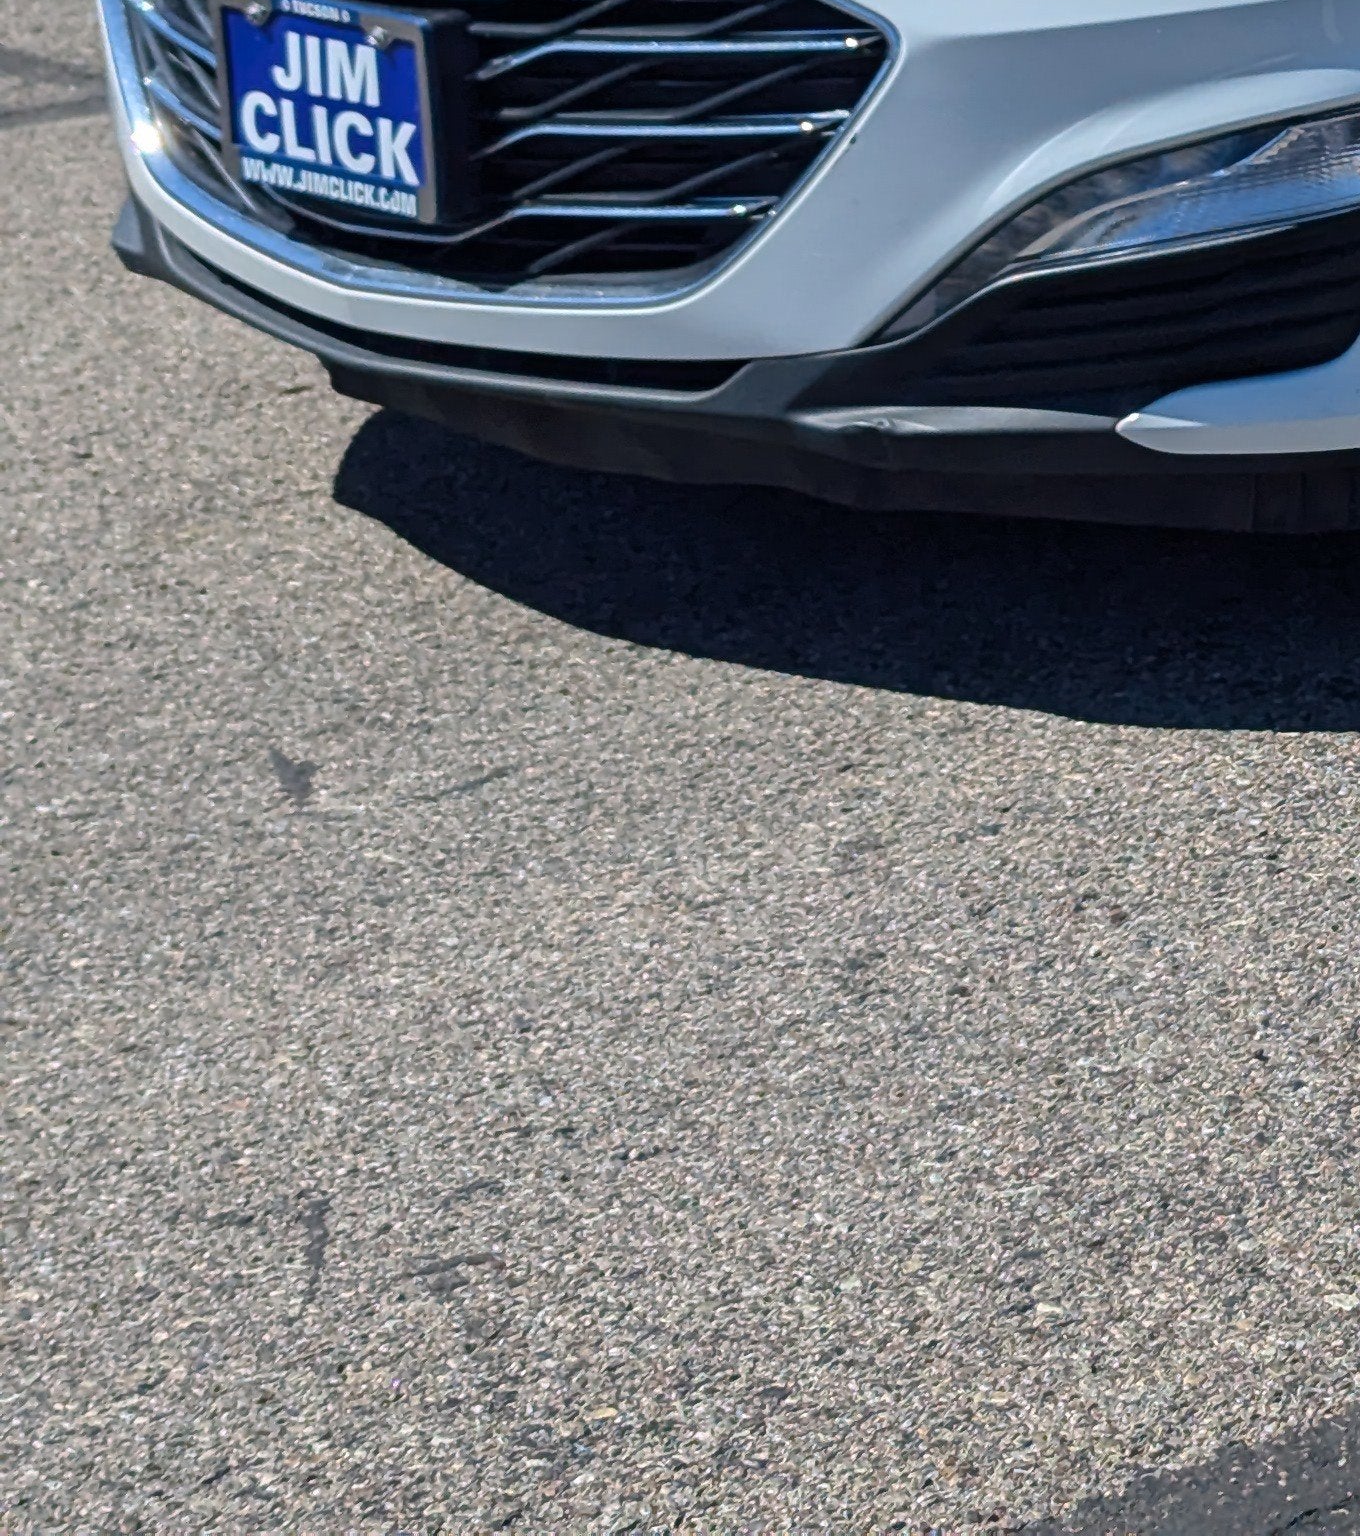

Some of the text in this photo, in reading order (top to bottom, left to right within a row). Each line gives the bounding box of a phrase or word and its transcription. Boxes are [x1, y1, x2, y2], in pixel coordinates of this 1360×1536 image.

[271, 30, 381, 107] JIM
[241, 90, 420, 187] CLICK
[241, 156, 418, 217] WWW.JIMCLICK.COM
